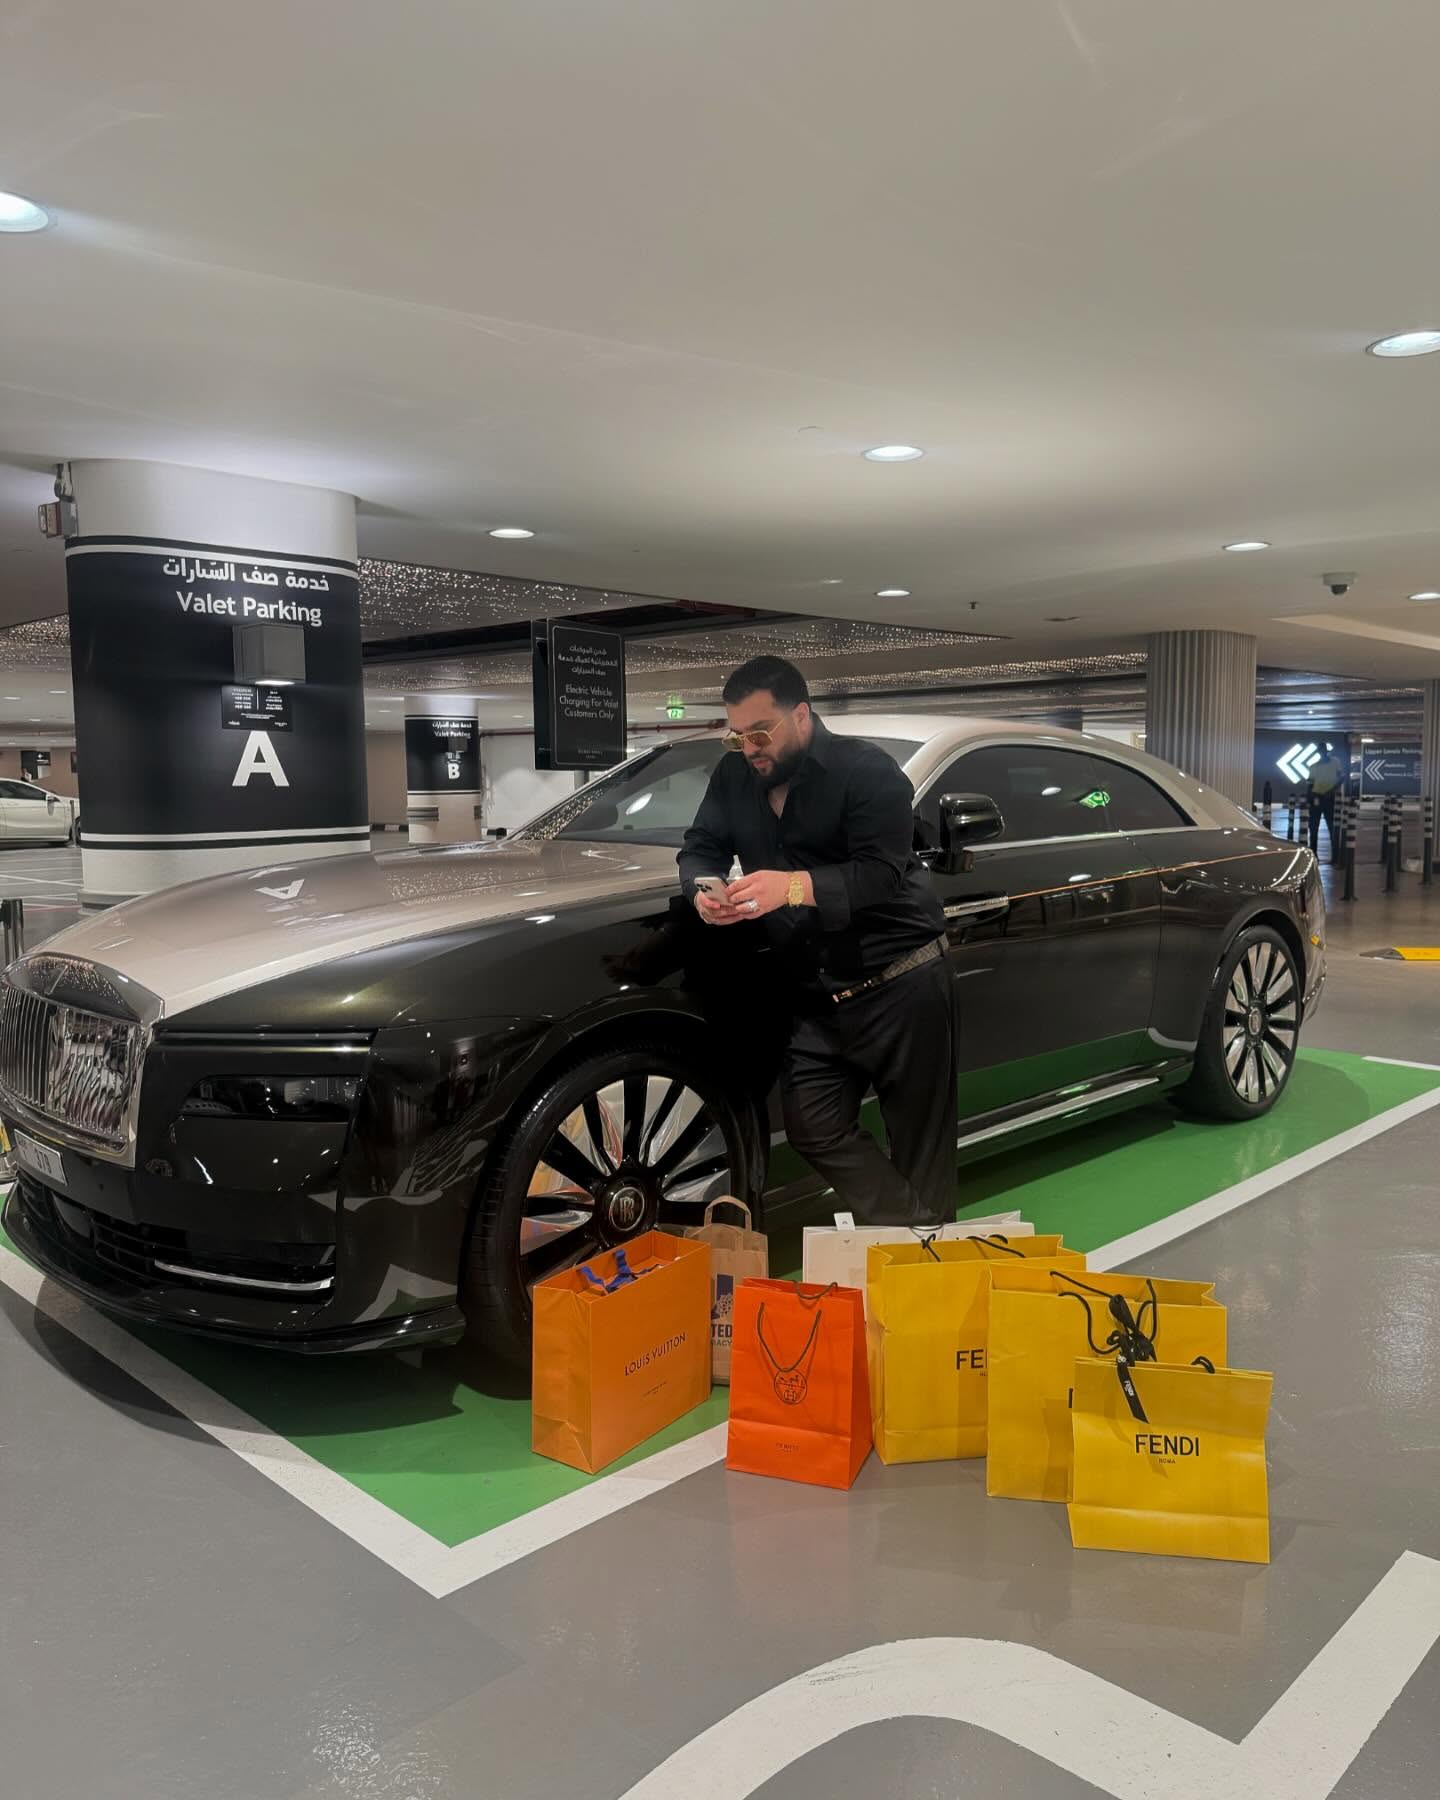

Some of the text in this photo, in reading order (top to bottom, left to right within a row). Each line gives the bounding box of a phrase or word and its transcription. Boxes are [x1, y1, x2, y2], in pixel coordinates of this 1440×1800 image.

[242, 566, 279, 586] صف
[285, 571, 330, 591] خدمة
[176, 591, 323, 627] Valet Parking
[565, 683, 612, 697] Electric Vehicle
[560, 695, 619, 709] Charging For Valet
[564, 708, 615, 721] Customers Only
[231, 730, 290, 787] A
[448, 763, 461, 780] B
[624, 1331, 687, 1377] LOUIS VUITTON
[955, 1348, 988, 1370] FE
[1135, 1433, 1200, 1457] FENDI
